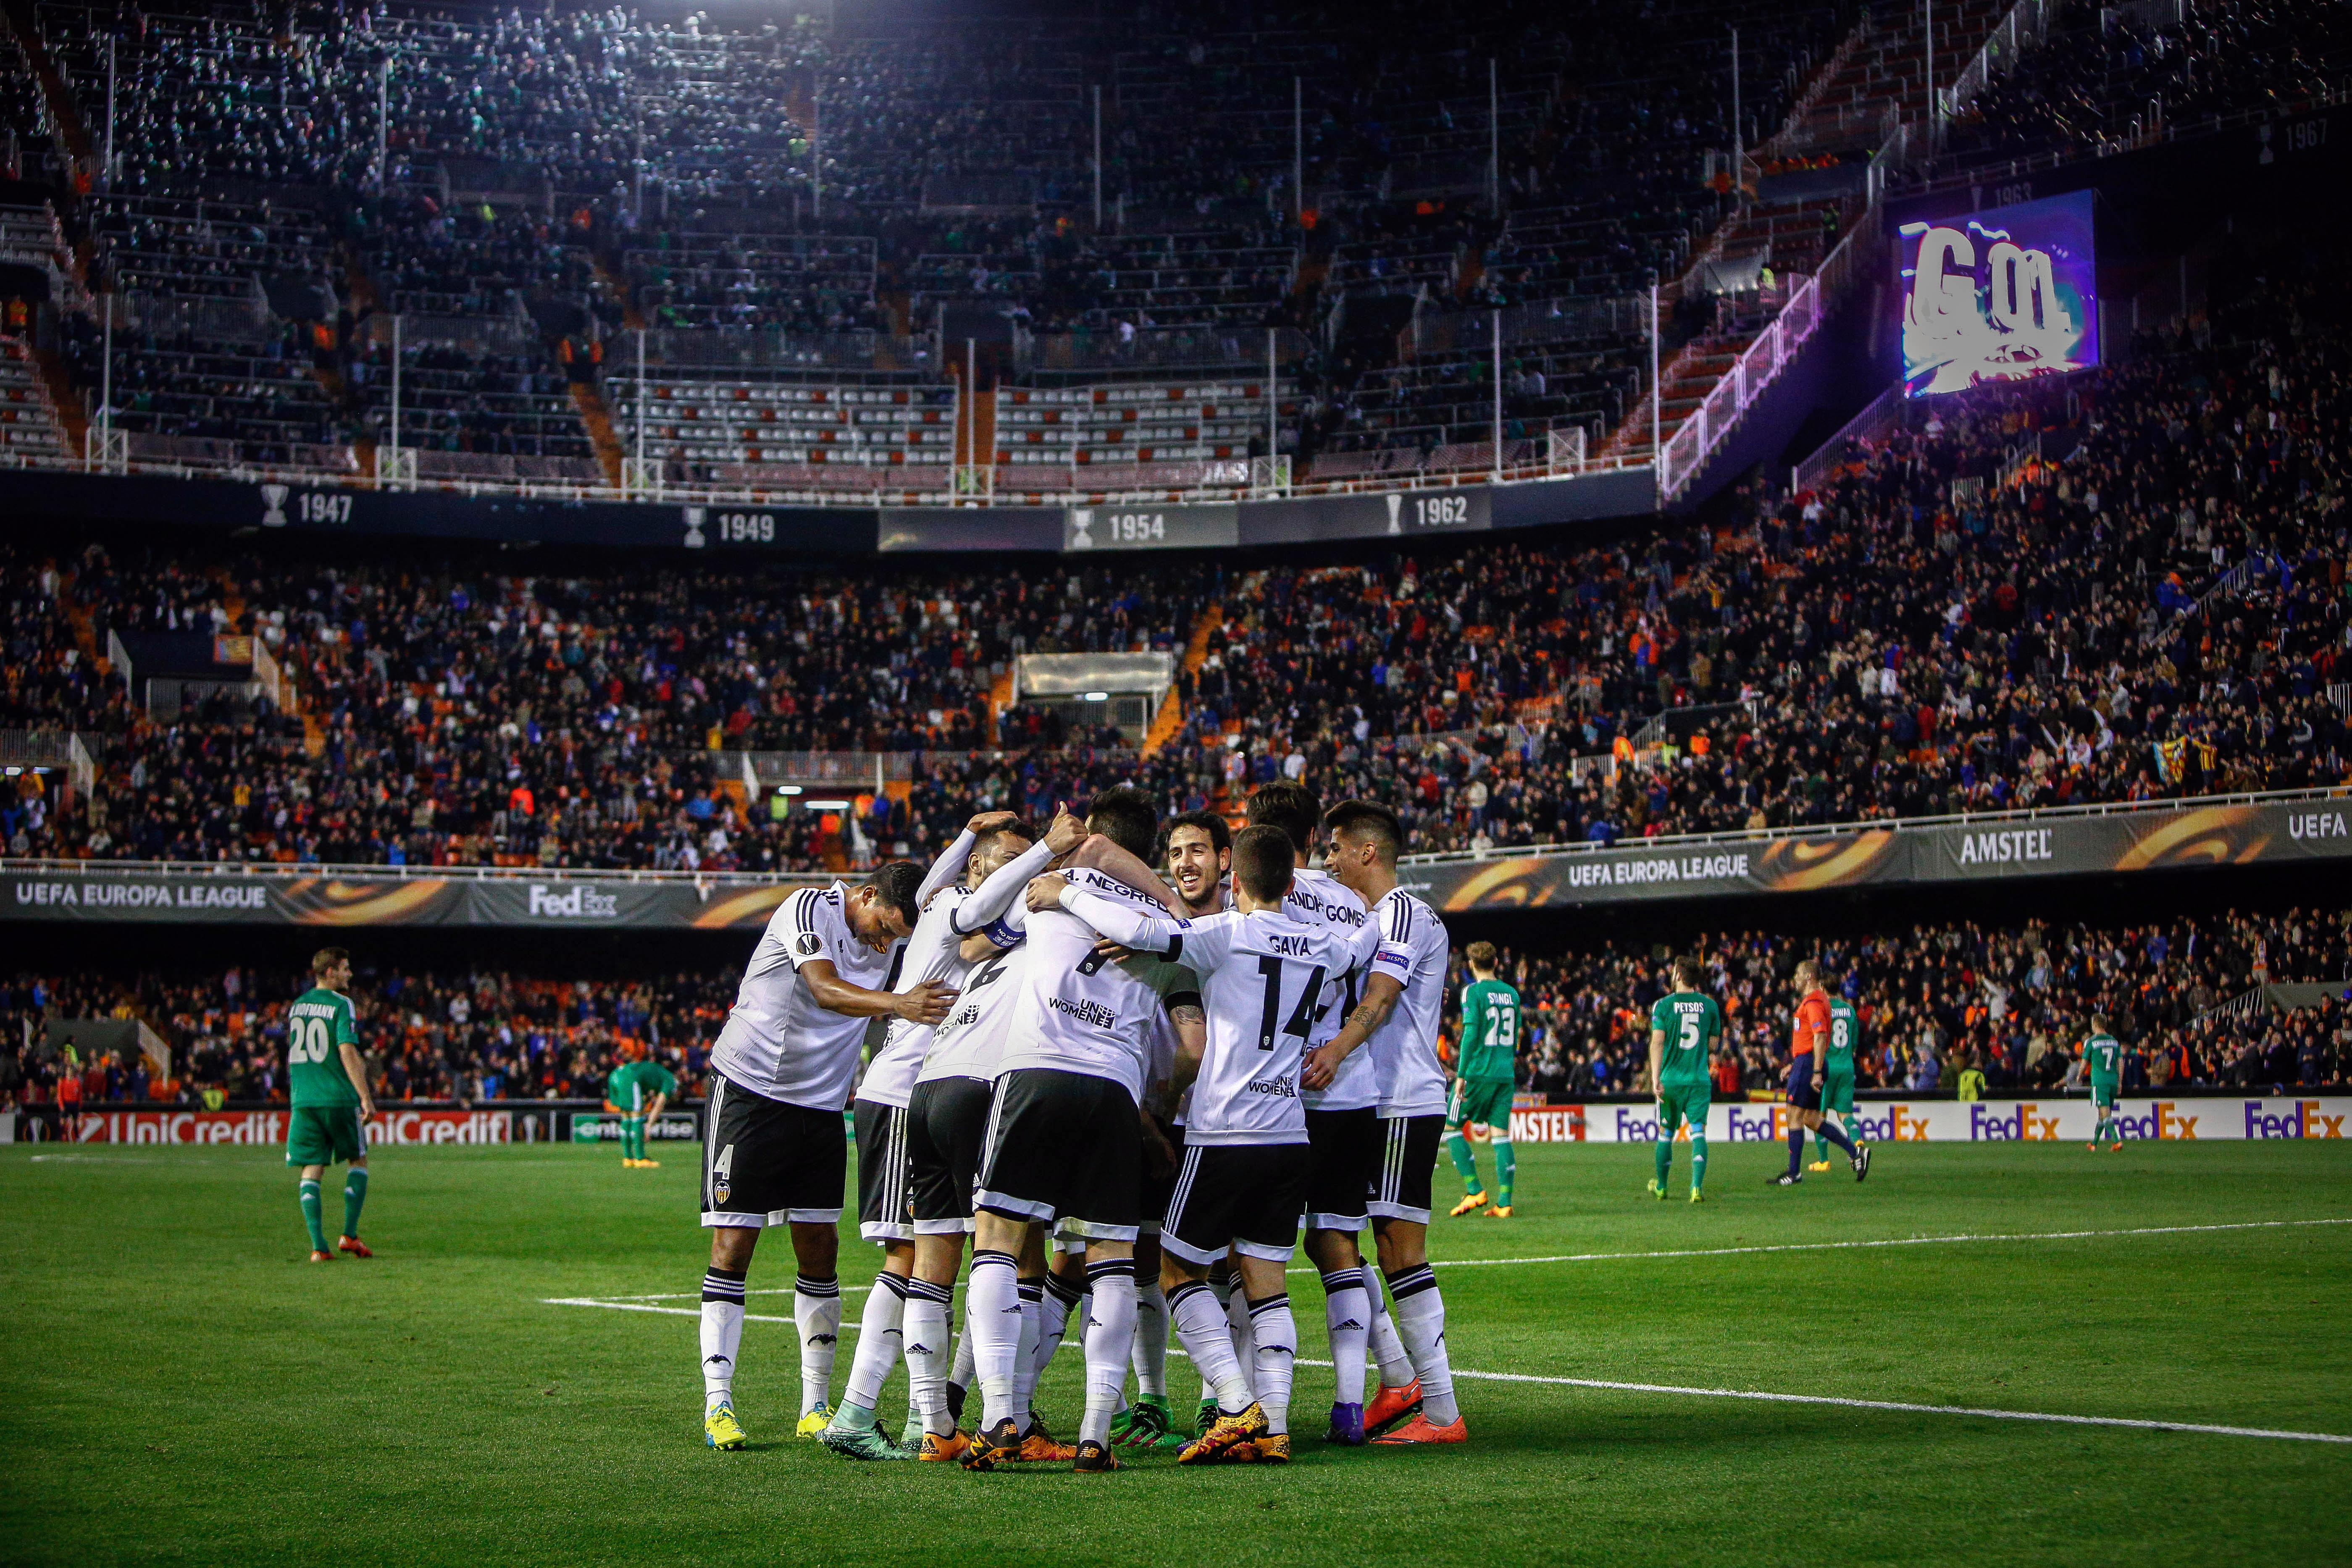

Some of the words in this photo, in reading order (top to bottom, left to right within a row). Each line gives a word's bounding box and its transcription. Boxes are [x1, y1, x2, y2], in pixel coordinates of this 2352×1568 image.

[2286, 118, 2327, 152] 1967
[299, 492, 353, 523] 1947
[1416, 496, 1467, 525] 1962
[718, 513, 775, 542] 1949
[1110, 514, 1164, 540] 1954
[2288, 812, 2347, 840] UEFA
[1960, 829, 2052, 865] AMSTEL
[1569, 864, 1611, 887] UEFA
[1615, 858, 1678, 884] EUROPA
[1682, 854, 1748, 879] LEAGUE
[16, 882, 78, 906] UEFA
[84, 884, 173, 907] EUROPA
[177, 885, 266, 909] LEAGUE
[529, 884, 617, 917] FedEx
[998, 928, 1006, 937] NO
[1387, 955, 1408, 966] RESPEC
[1049, 997, 1097, 1024] WOMEN
[1080, 998, 1100, 1014] UN
[1258, 955, 1326, 1057] 14
[1673, 1002, 1704, 1014] PETSOS
[1831, 1008, 1851, 1018] CHWAB
[289, 1016, 329, 1064] 20
[1484, 1006, 1515, 1046] 23
[1679, 1013, 1700, 1050] 5
[1832, 1018, 1849, 1049] 8
[2102, 1047, 2113, 1071] 7
[110, 1112, 281, 1145] UniCredit
[365, 1111, 505, 1145] niCredit
[577, 1120, 694, 1138] entrise
[1509, 1111, 1577, 1142] MSTEL
[1617, 1107, 1691, 1143] Fedx
[1729, 1106, 1787, 1142] FedE
[1971, 1103, 2060, 1141] FedEx
[2244, 1100, 2345, 1140] FedEx
[713, 1144, 734, 1180] 4
[920, 1447, 940, 1455] didas
